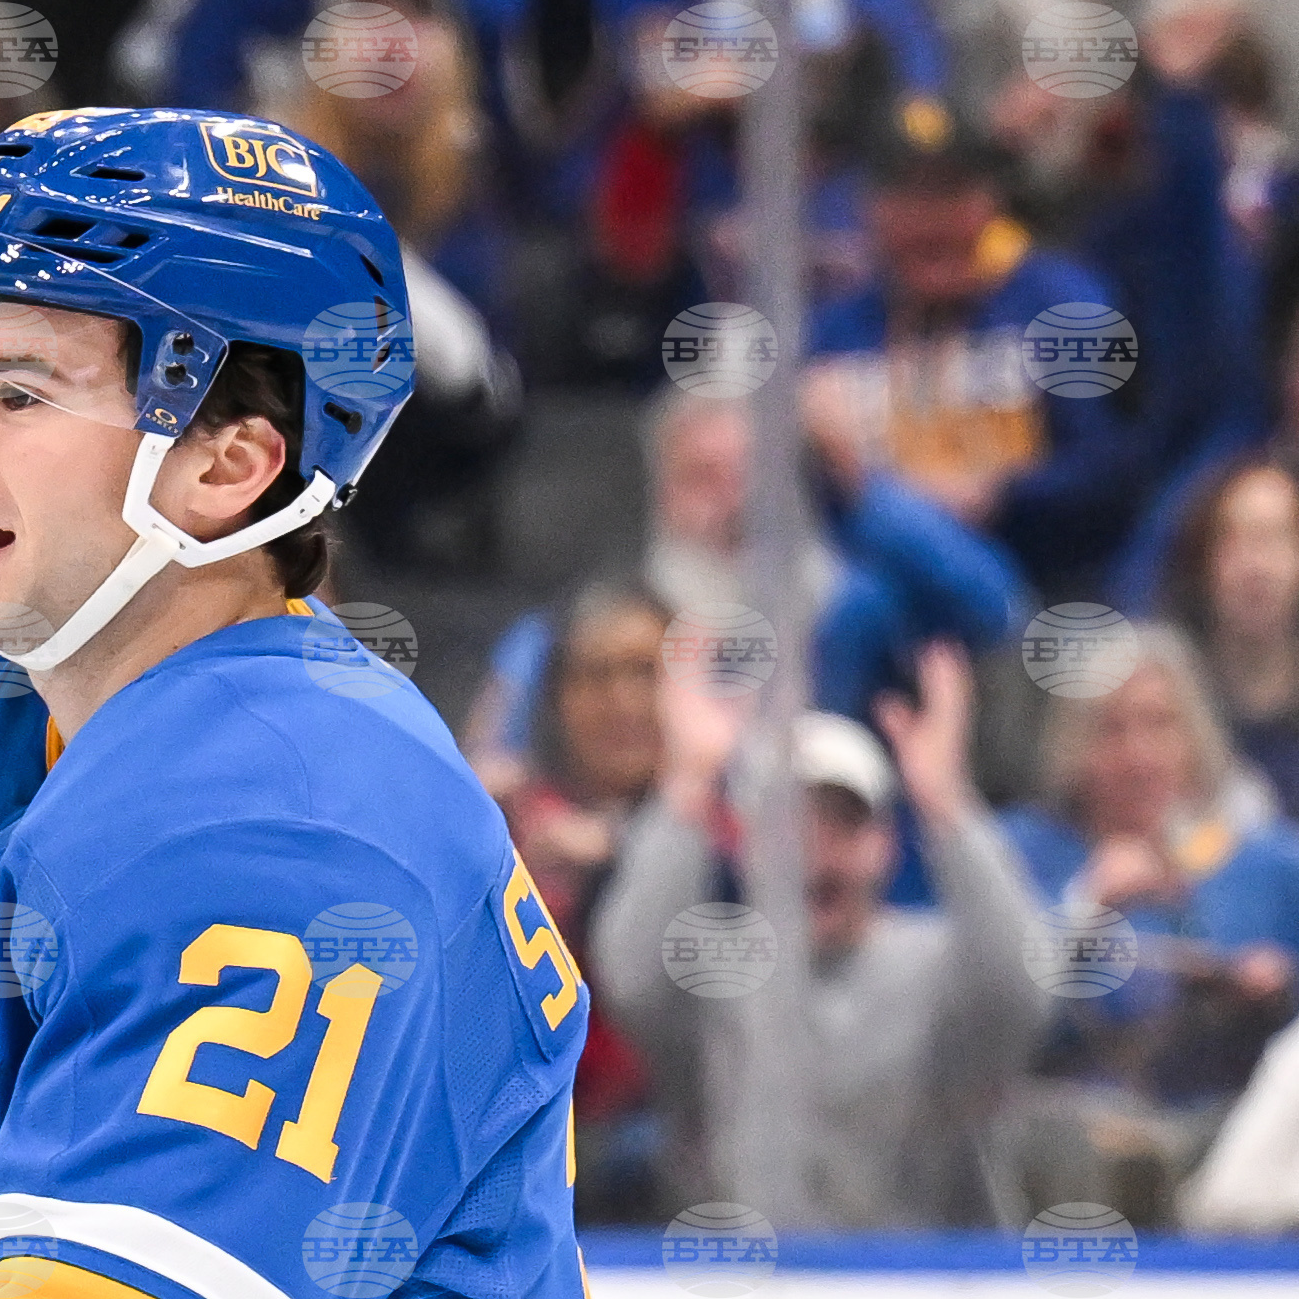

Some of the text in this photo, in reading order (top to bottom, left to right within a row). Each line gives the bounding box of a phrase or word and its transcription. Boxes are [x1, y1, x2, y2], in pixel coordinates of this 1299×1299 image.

[216, 186, 322, 220] HealthCare
[223, 136, 303, 178] BJC
[503, 848, 582, 1031] S
[137, 924, 384, 1184] 21
